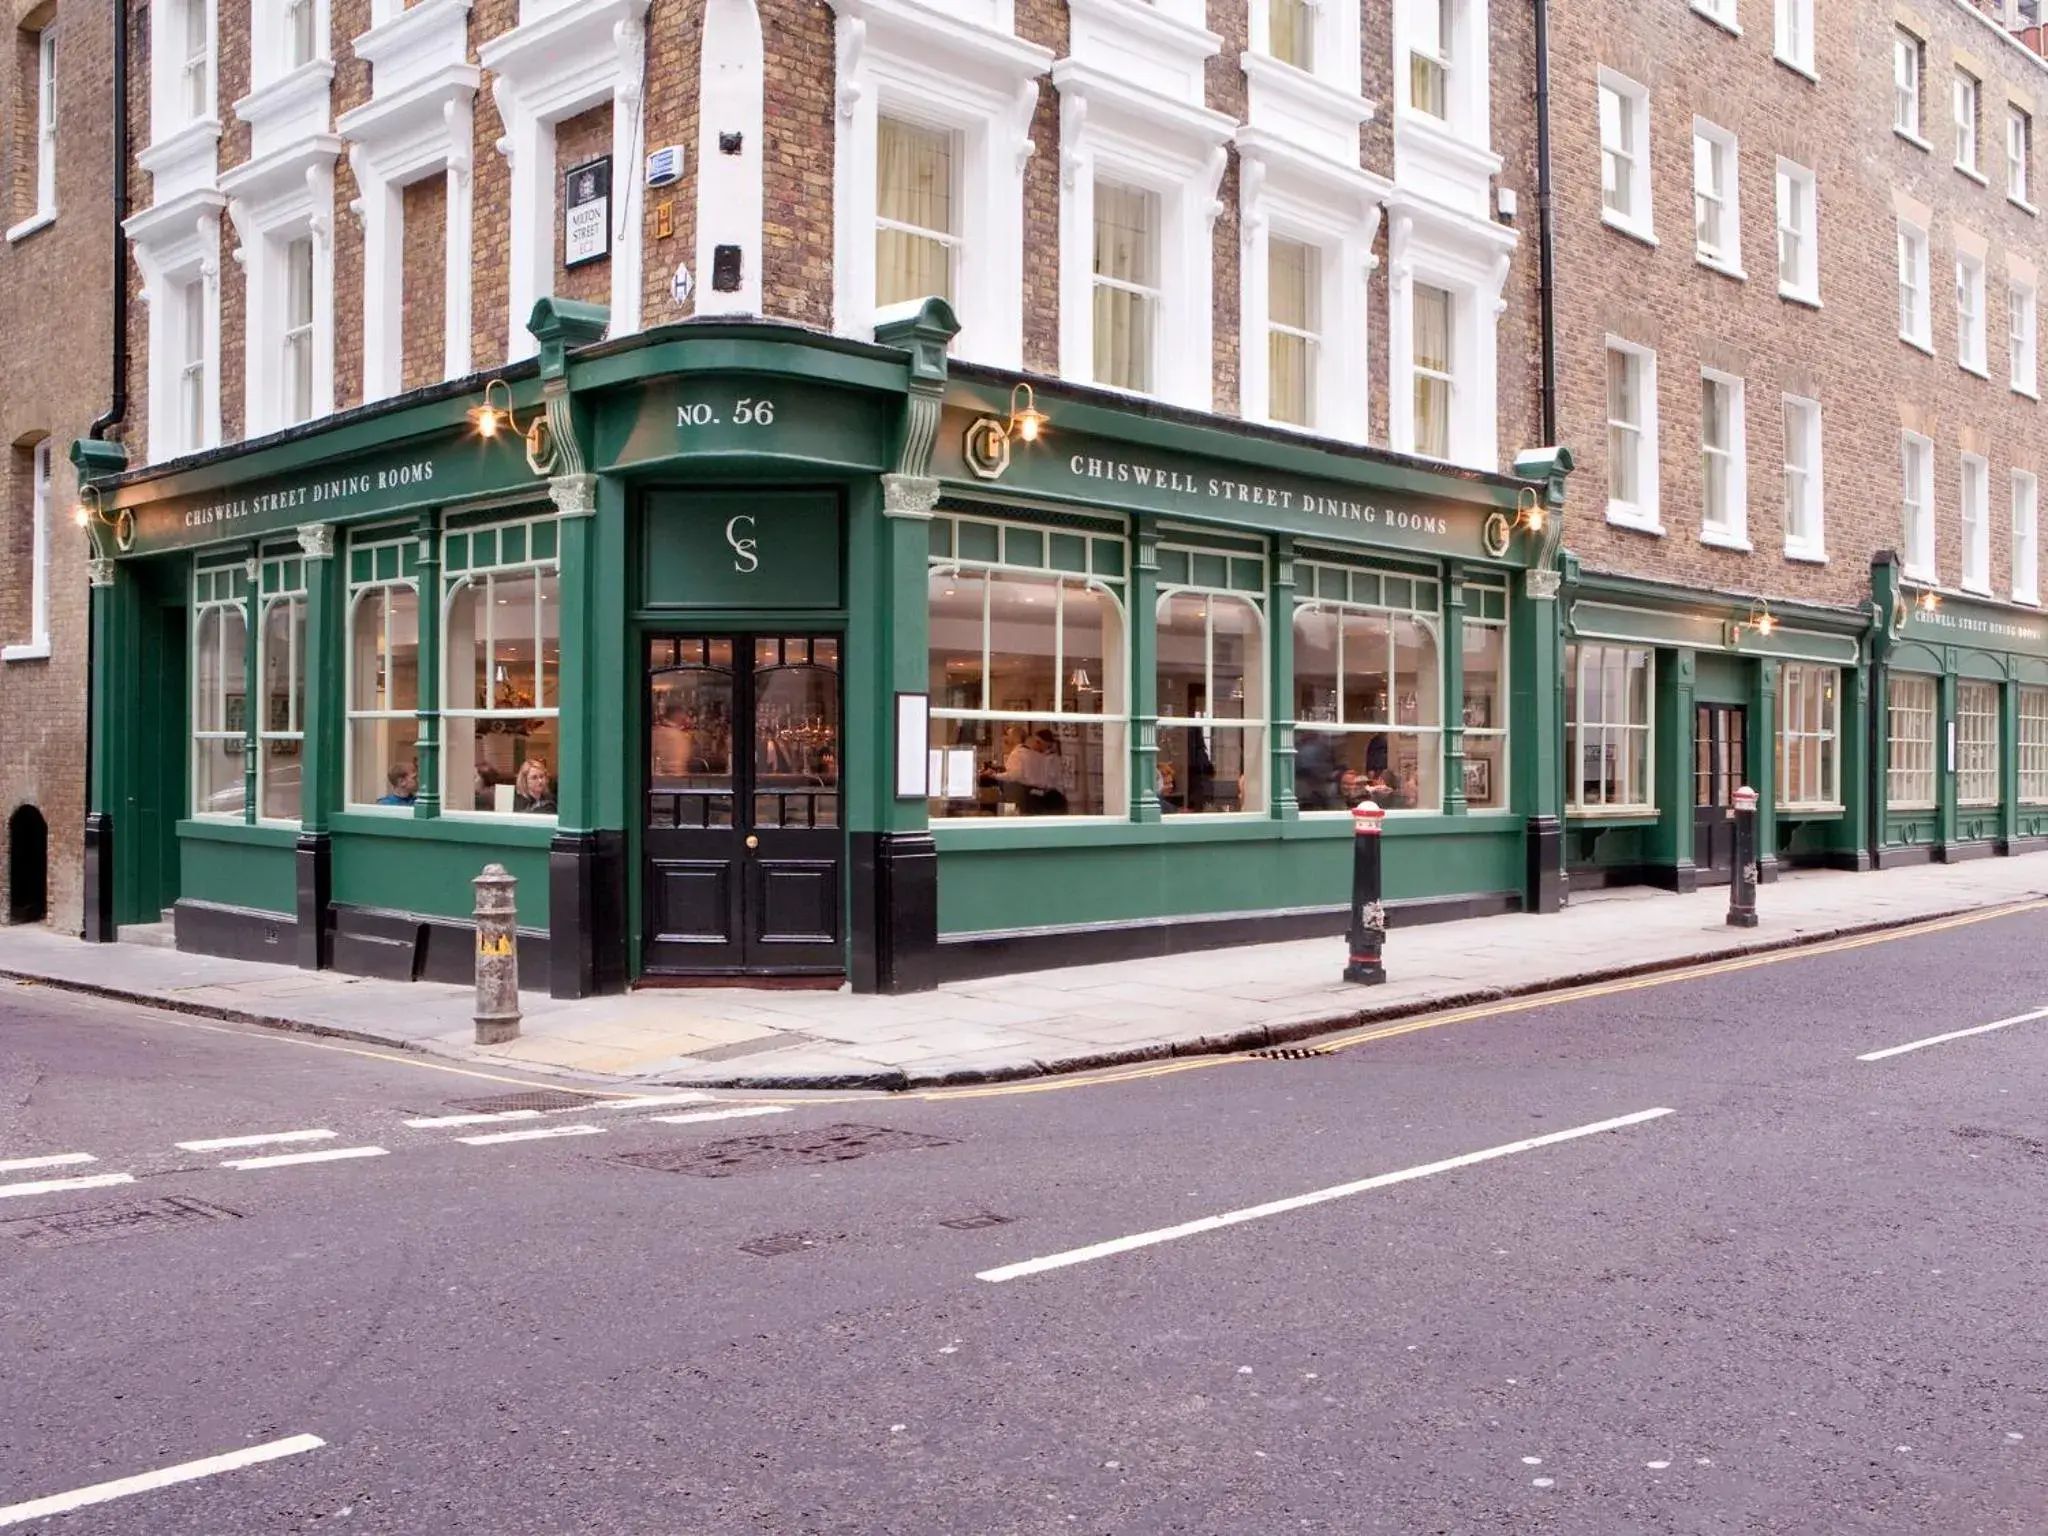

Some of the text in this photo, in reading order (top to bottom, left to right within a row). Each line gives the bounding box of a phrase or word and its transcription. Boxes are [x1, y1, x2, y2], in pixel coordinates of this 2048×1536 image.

[572, 208, 600, 225] MILTON
[572, 223, 599, 242] STREET
[675, 272, 687, 297] H
[677, 398, 775, 427] NO. 56
[185, 461, 433, 527] CHISWELL STREET DINING ROOMS
[1070, 455, 1447, 535] CHISWELL STREET DINING ROOMS
[1914, 610, 1956, 628] CHISWELL
[1959, 616, 1987, 632] STREET
